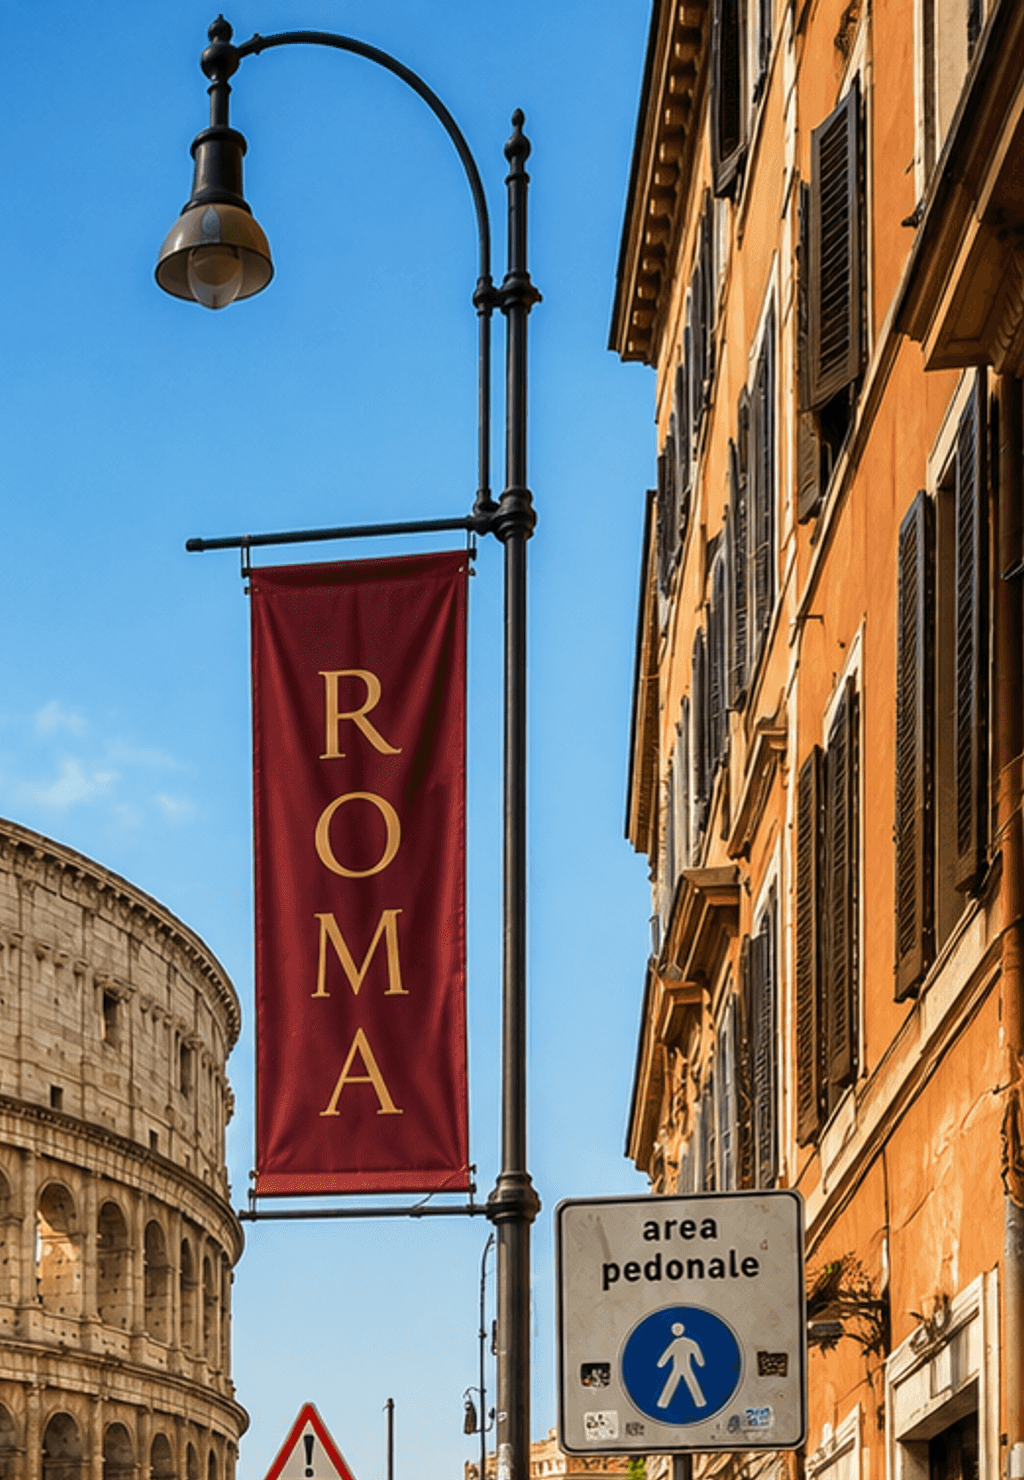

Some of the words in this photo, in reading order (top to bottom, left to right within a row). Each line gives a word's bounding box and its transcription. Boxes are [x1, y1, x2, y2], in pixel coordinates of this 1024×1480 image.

[311, 669, 409, 1116] ROMA
[643, 1218, 717, 1241] area
[602, 1249, 759, 1291] pedonale
